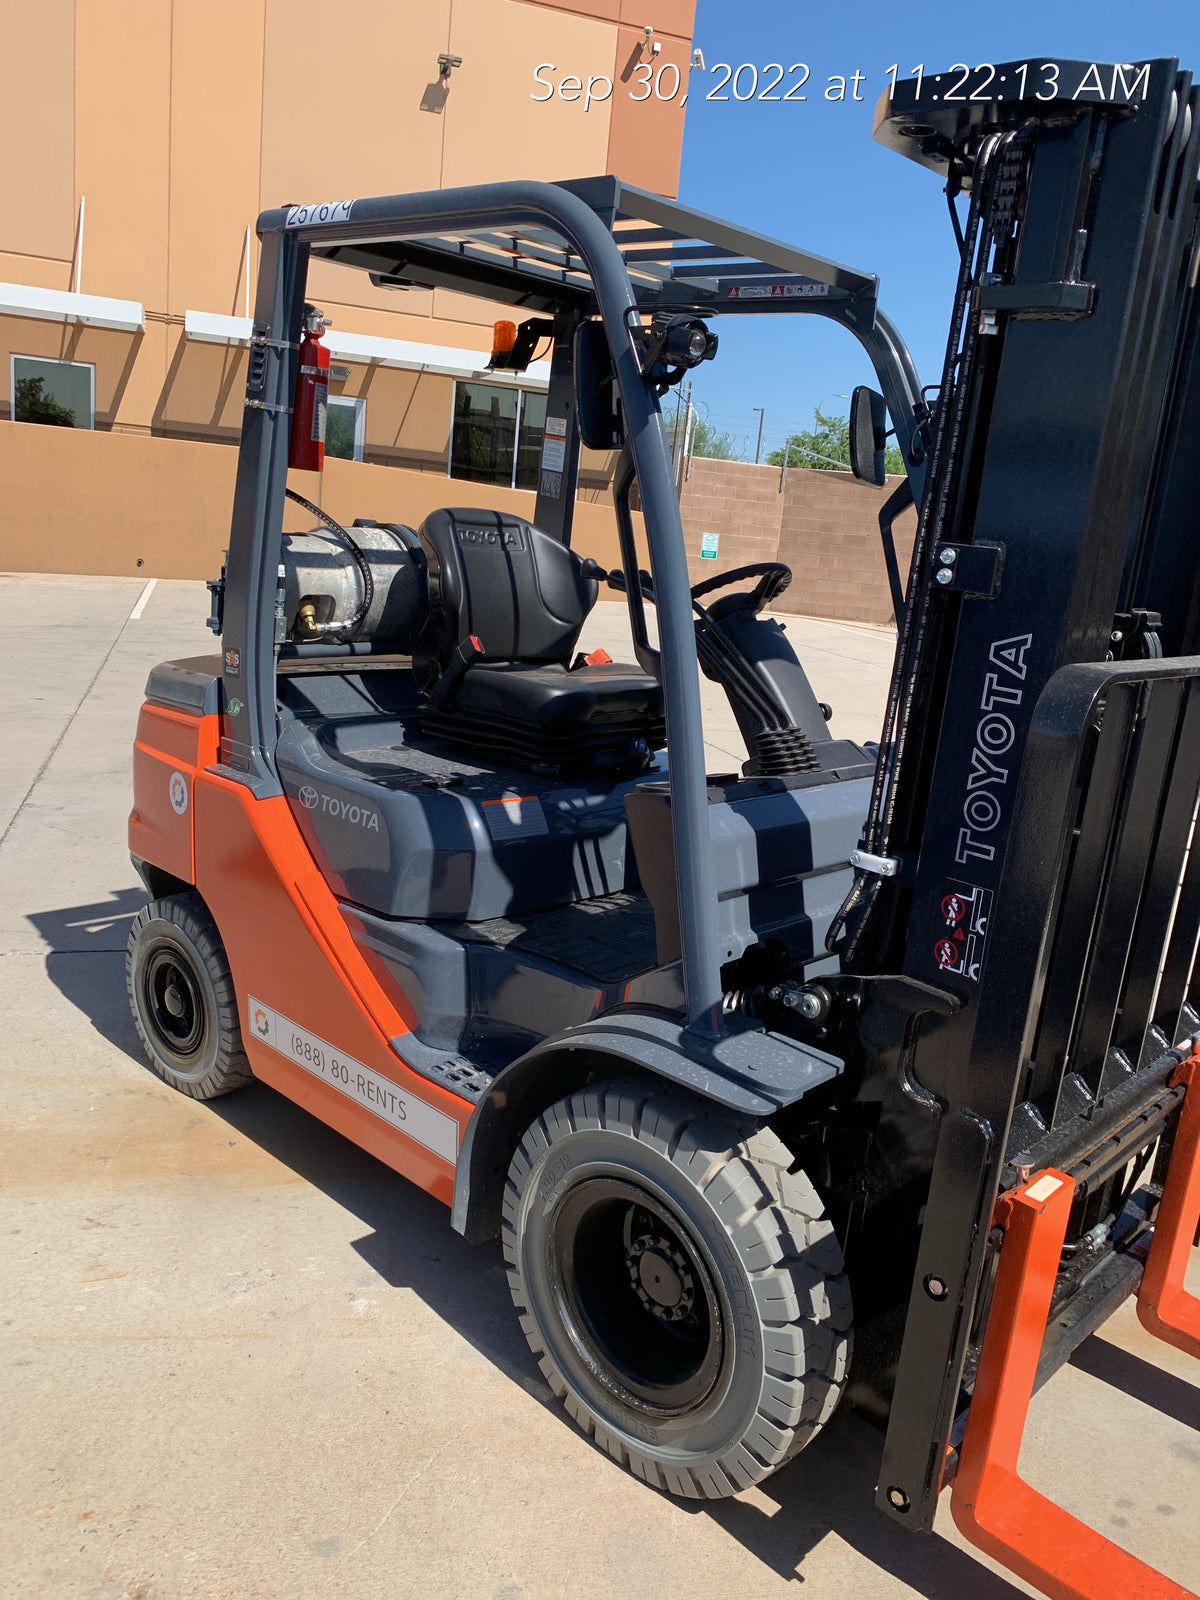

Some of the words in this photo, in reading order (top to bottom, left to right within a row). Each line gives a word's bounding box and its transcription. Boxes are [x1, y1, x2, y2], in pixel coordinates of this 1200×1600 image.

[457, 528, 518, 546] TOYOTA
[954, 633, 1033, 864] TOYOTA
[321, 794, 379, 832] TOYOTA
[291, 1033, 326, 1072] (888)
[331, 1060, 407, 1121] 80-RENTS
